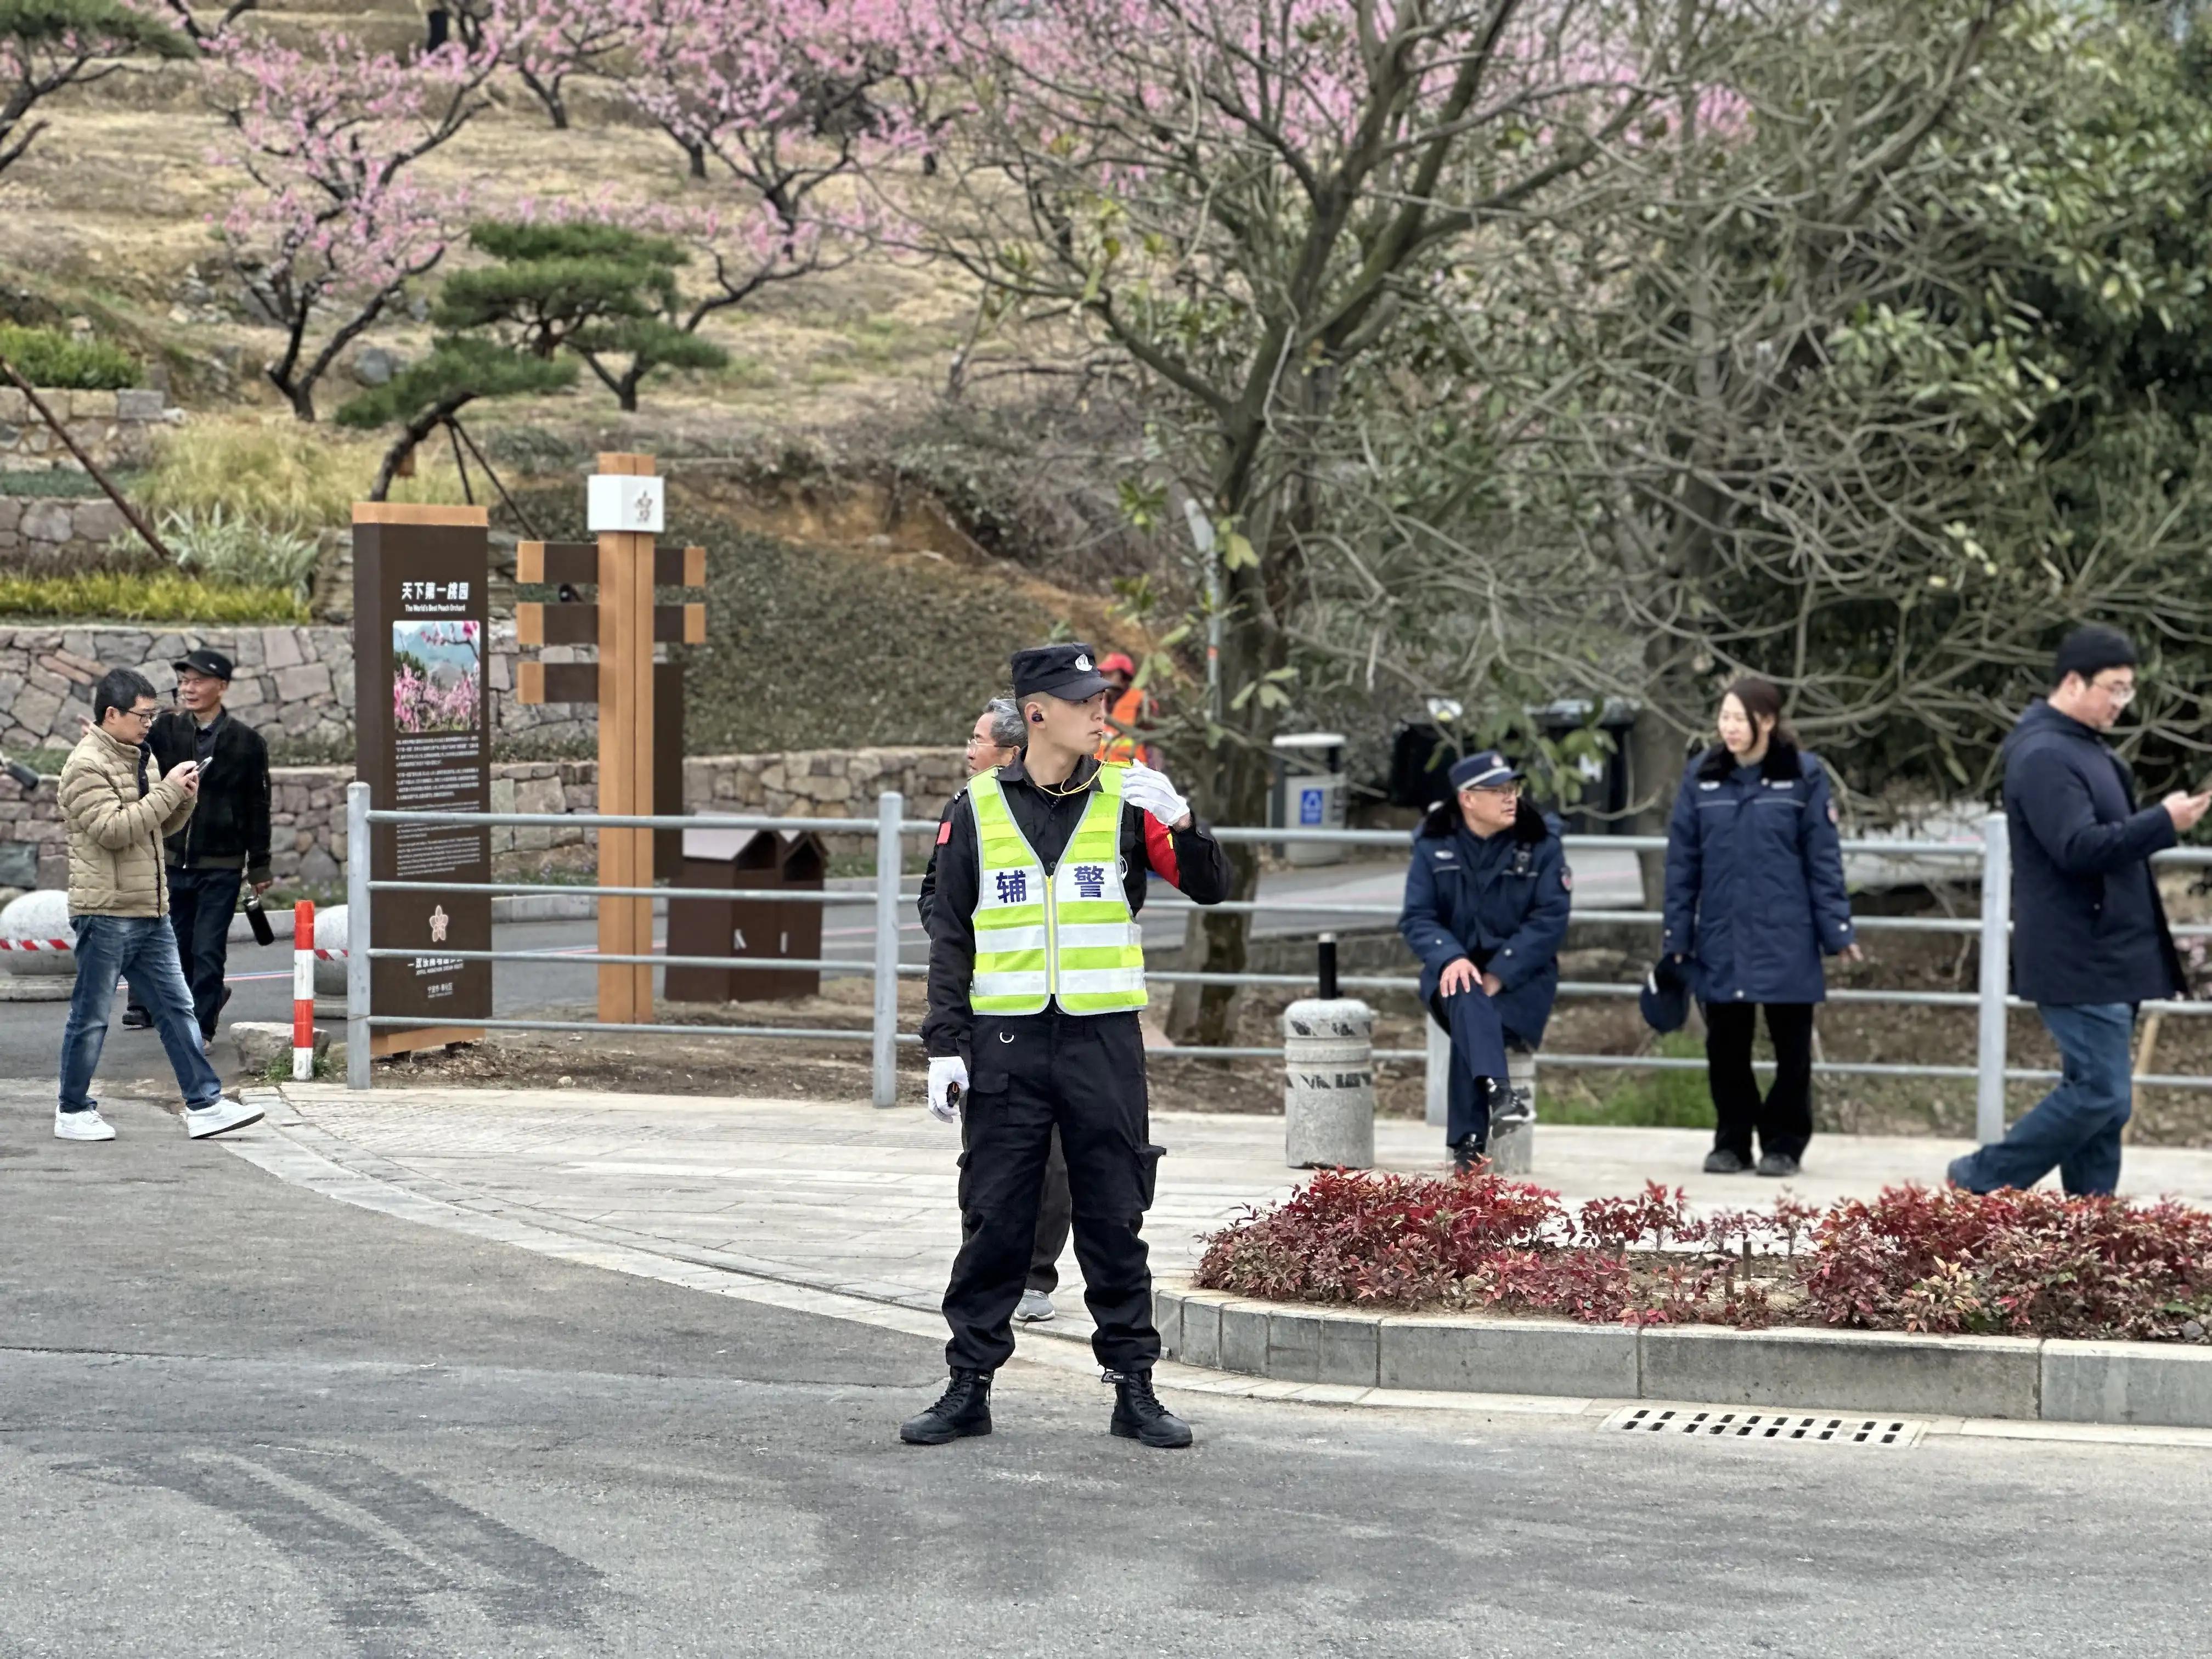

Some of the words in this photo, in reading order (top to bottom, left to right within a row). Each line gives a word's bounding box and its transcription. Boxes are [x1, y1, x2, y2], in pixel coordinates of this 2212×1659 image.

[401, 582, 469, 600] 天下第一桃园
